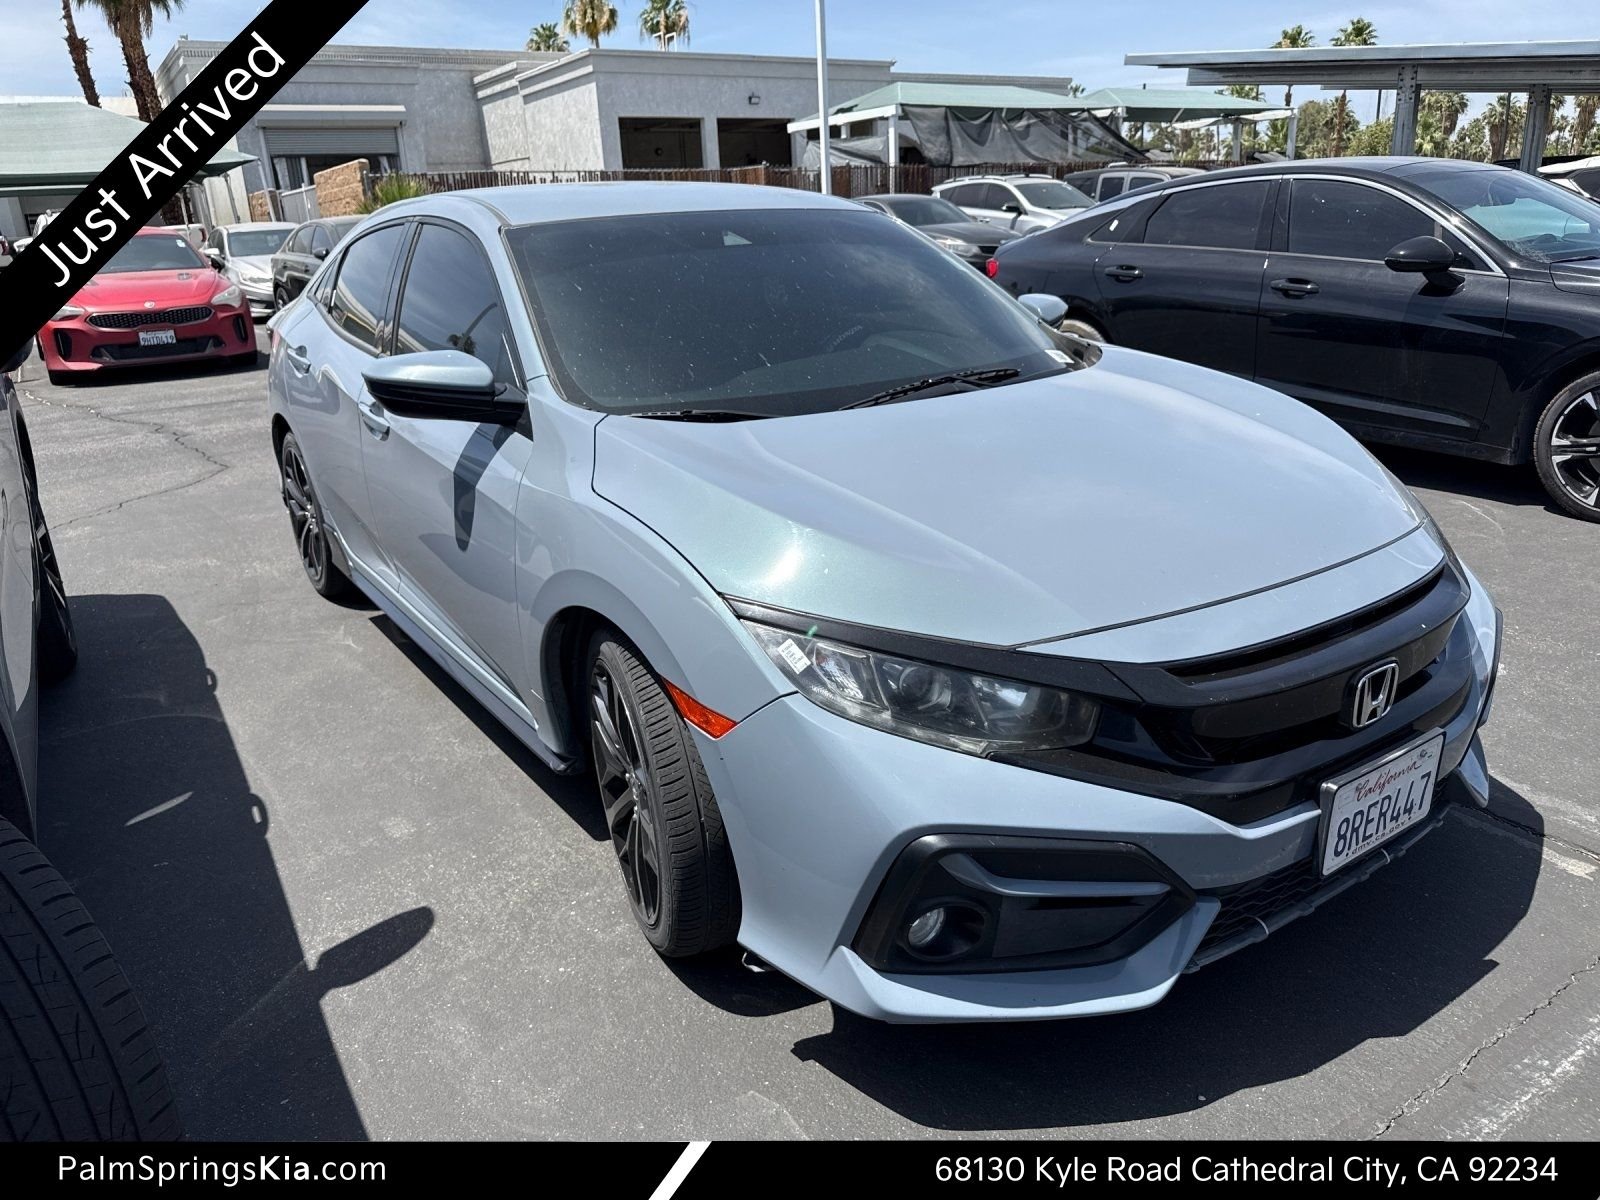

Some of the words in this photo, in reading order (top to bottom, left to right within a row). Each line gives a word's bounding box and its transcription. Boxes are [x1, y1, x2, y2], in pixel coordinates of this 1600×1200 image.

[1355, 761, 1422, 802] California
[1333, 770, 1432, 858] 8RER447
[1351, 819, 1406, 856] dmv.ca.gov
